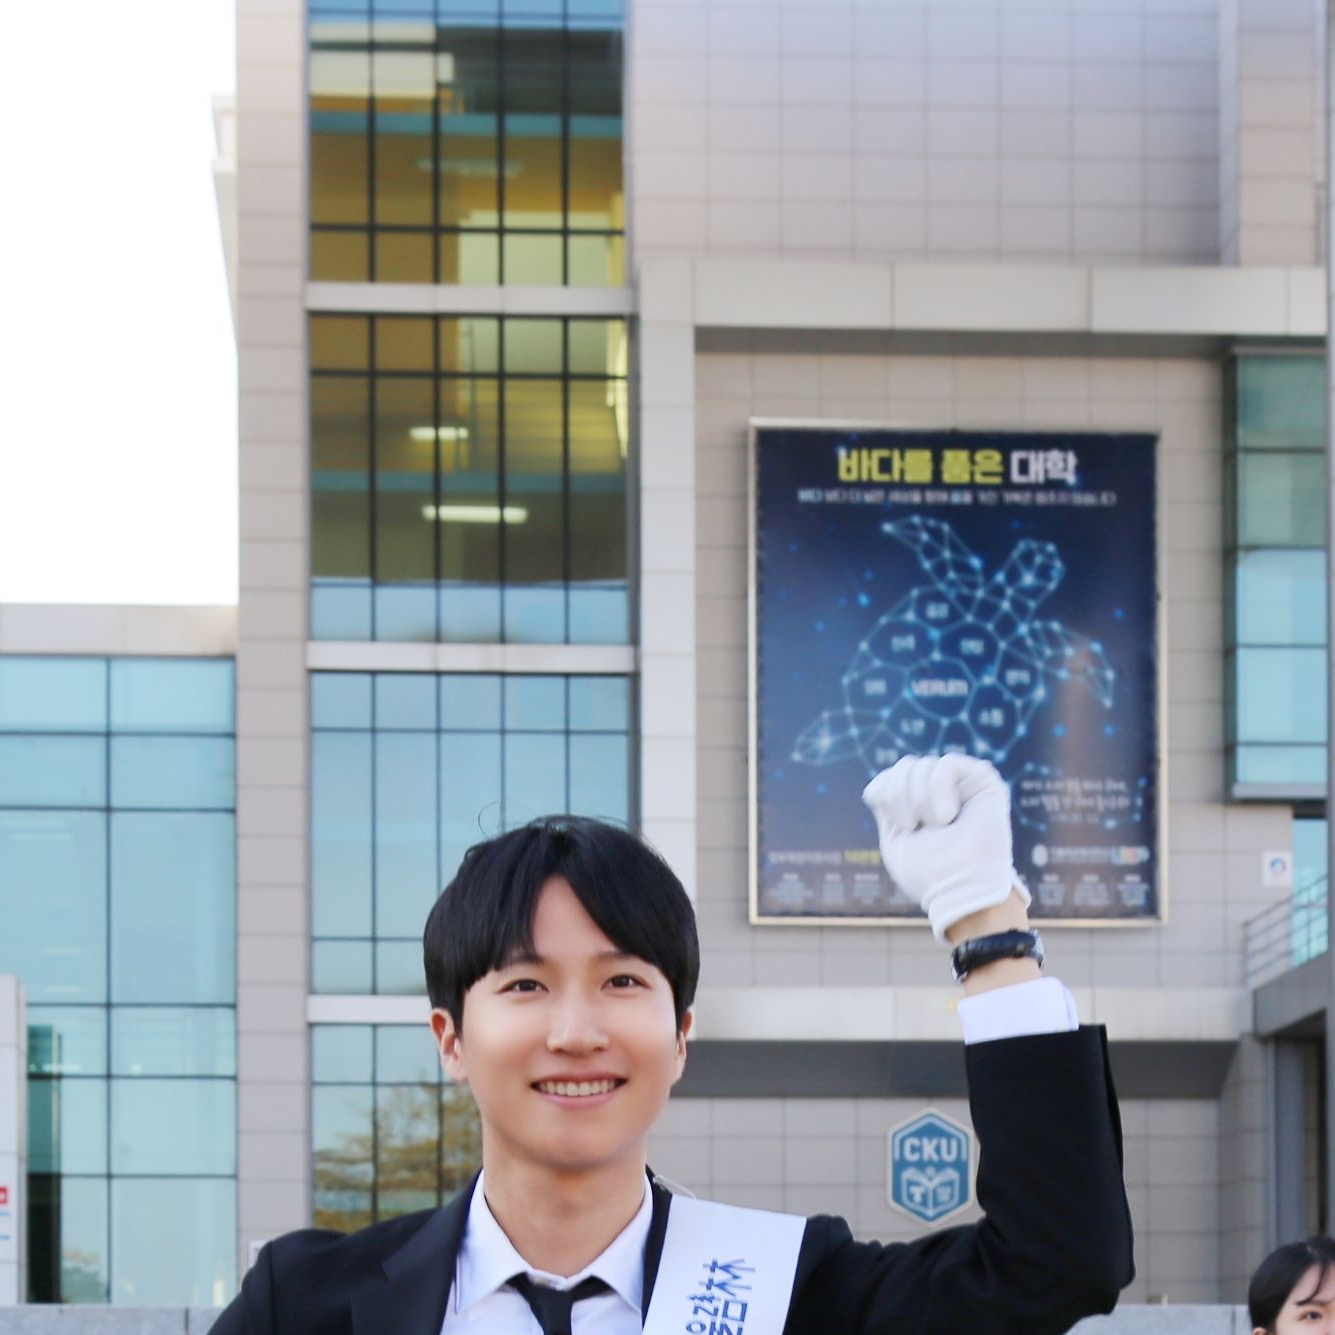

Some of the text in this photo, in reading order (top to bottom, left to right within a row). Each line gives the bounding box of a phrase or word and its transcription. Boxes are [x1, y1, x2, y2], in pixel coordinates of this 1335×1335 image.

[837, 448, 1078, 484] 바다를 품은 대학
[903, 1136, 958, 1162] CKU
